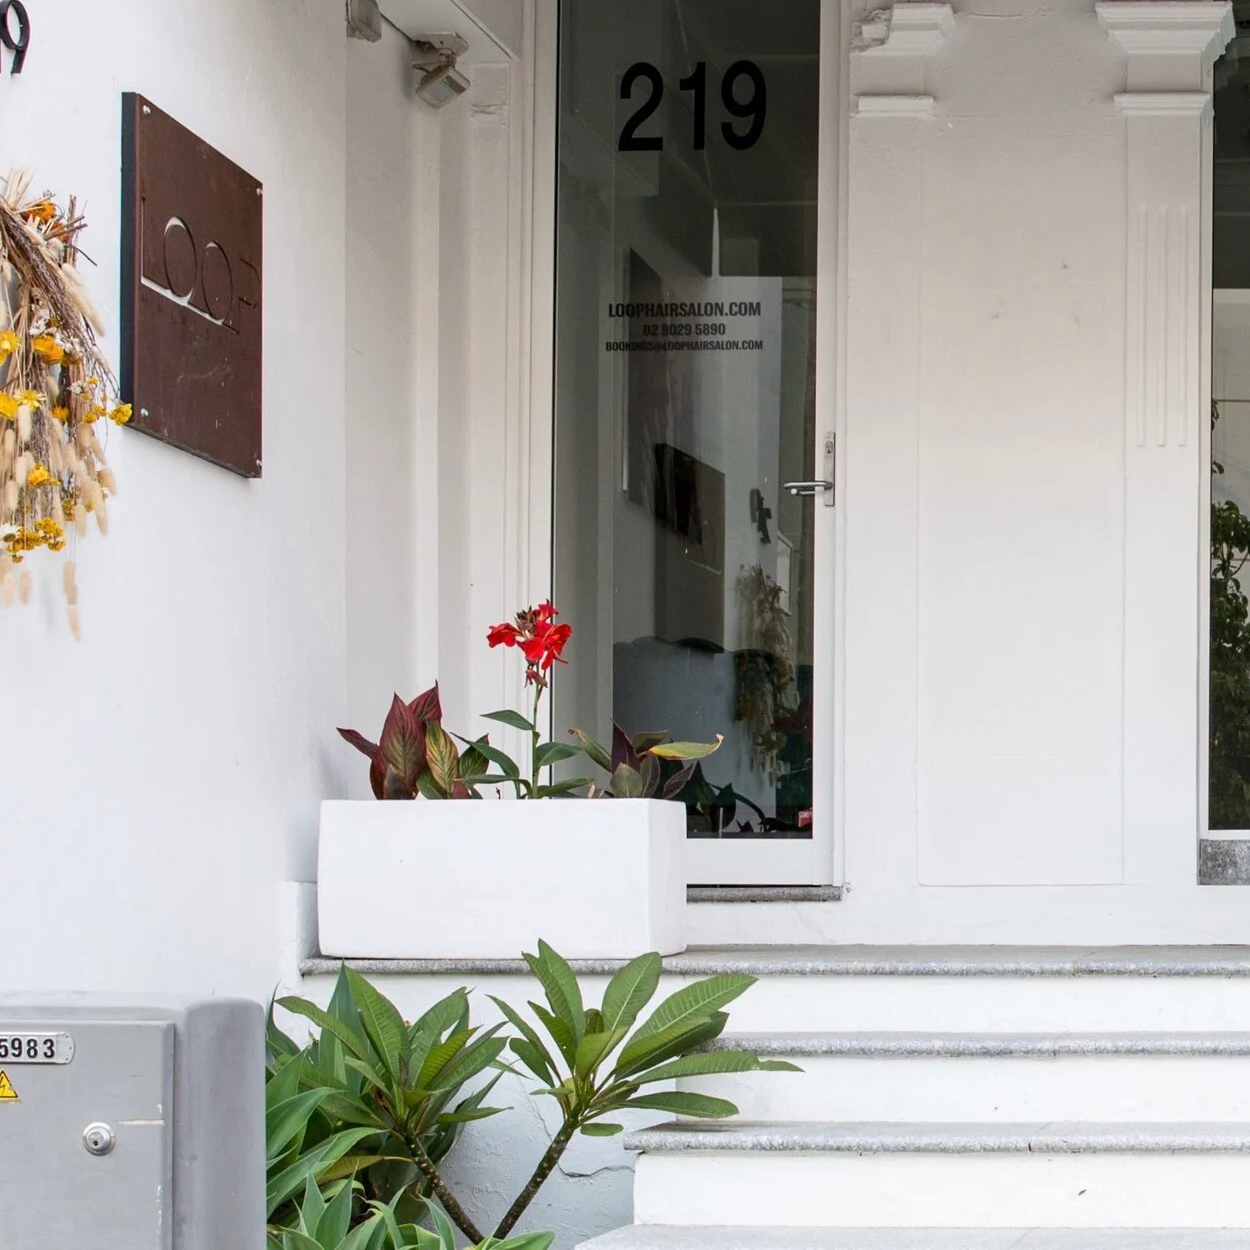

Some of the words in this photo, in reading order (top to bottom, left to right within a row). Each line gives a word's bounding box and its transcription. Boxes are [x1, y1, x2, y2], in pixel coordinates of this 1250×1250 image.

[617, 59, 767, 152] 219
[608, 301, 761, 318] LOOPHAIRSALON.COM
[643, 324, 659, 336] 02
[661, 323, 692, 336] 9029
[695, 322, 726, 336] 5890
[0, 1037, 55, 1059] 5983
